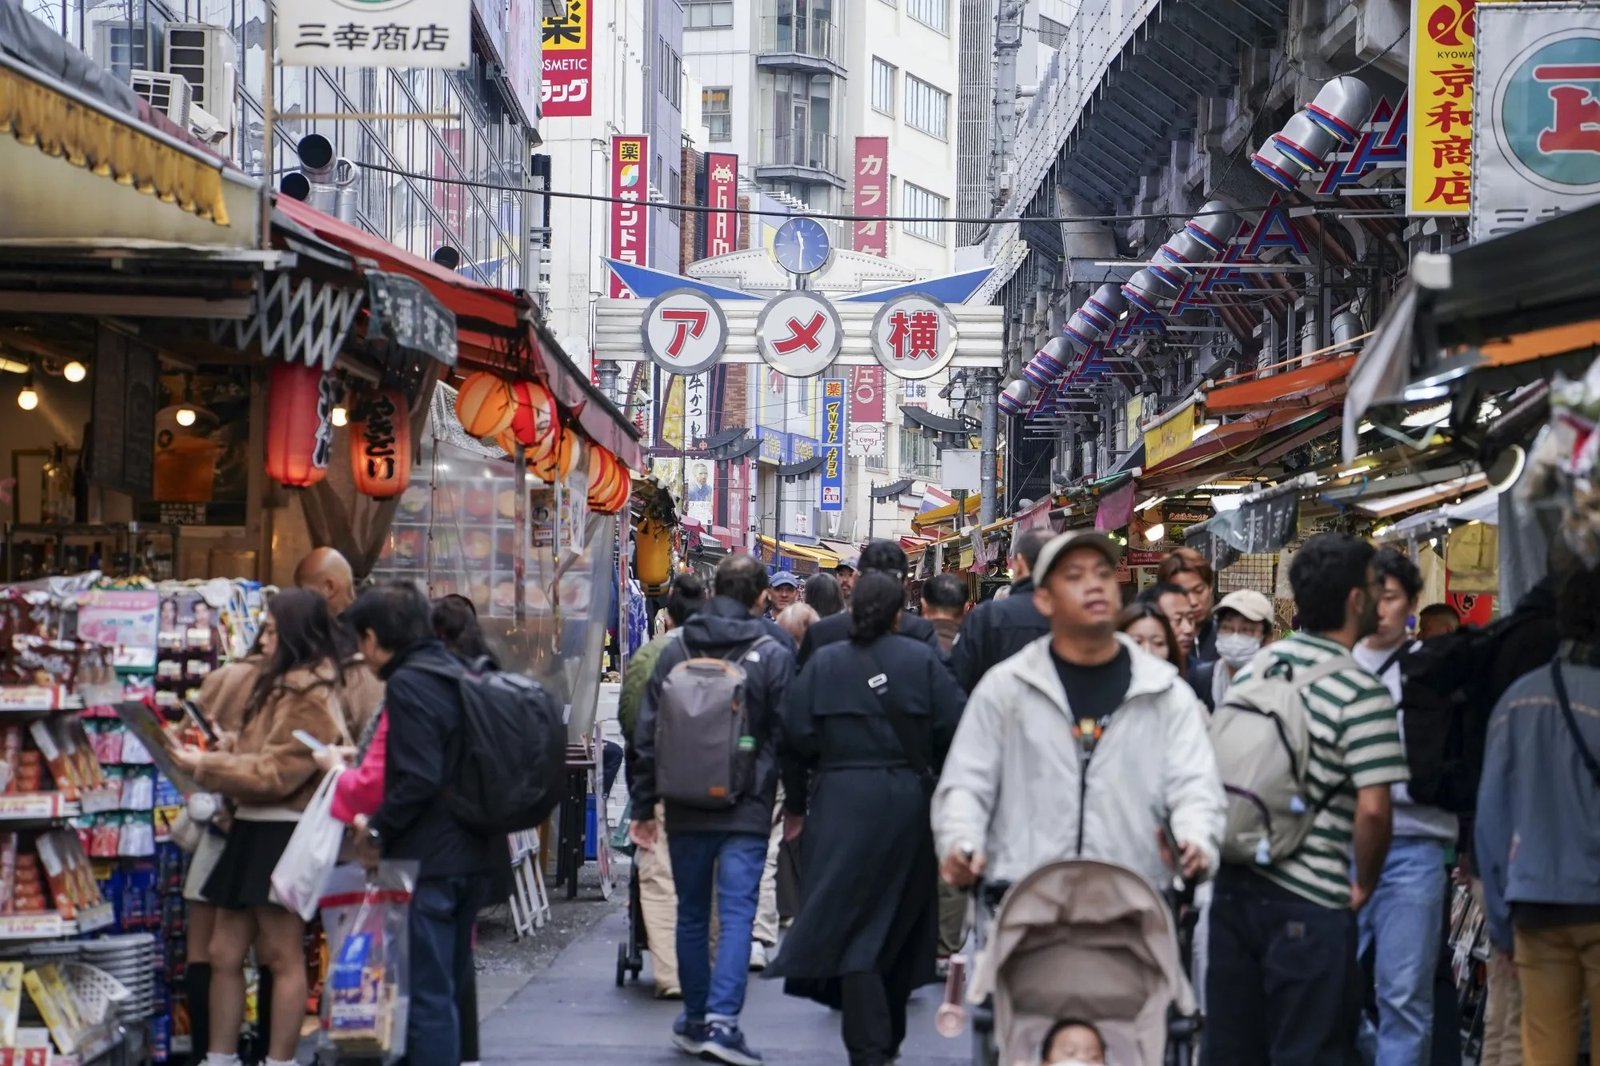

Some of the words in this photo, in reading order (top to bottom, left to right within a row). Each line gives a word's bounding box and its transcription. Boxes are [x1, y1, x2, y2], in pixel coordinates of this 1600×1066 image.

[295, 22, 449, 51] 三幸商店
[622, 143, 638, 160] 薬
[1424, 63, 1474, 205] 京和商店
[660, 309, 939, 360] アメ横
